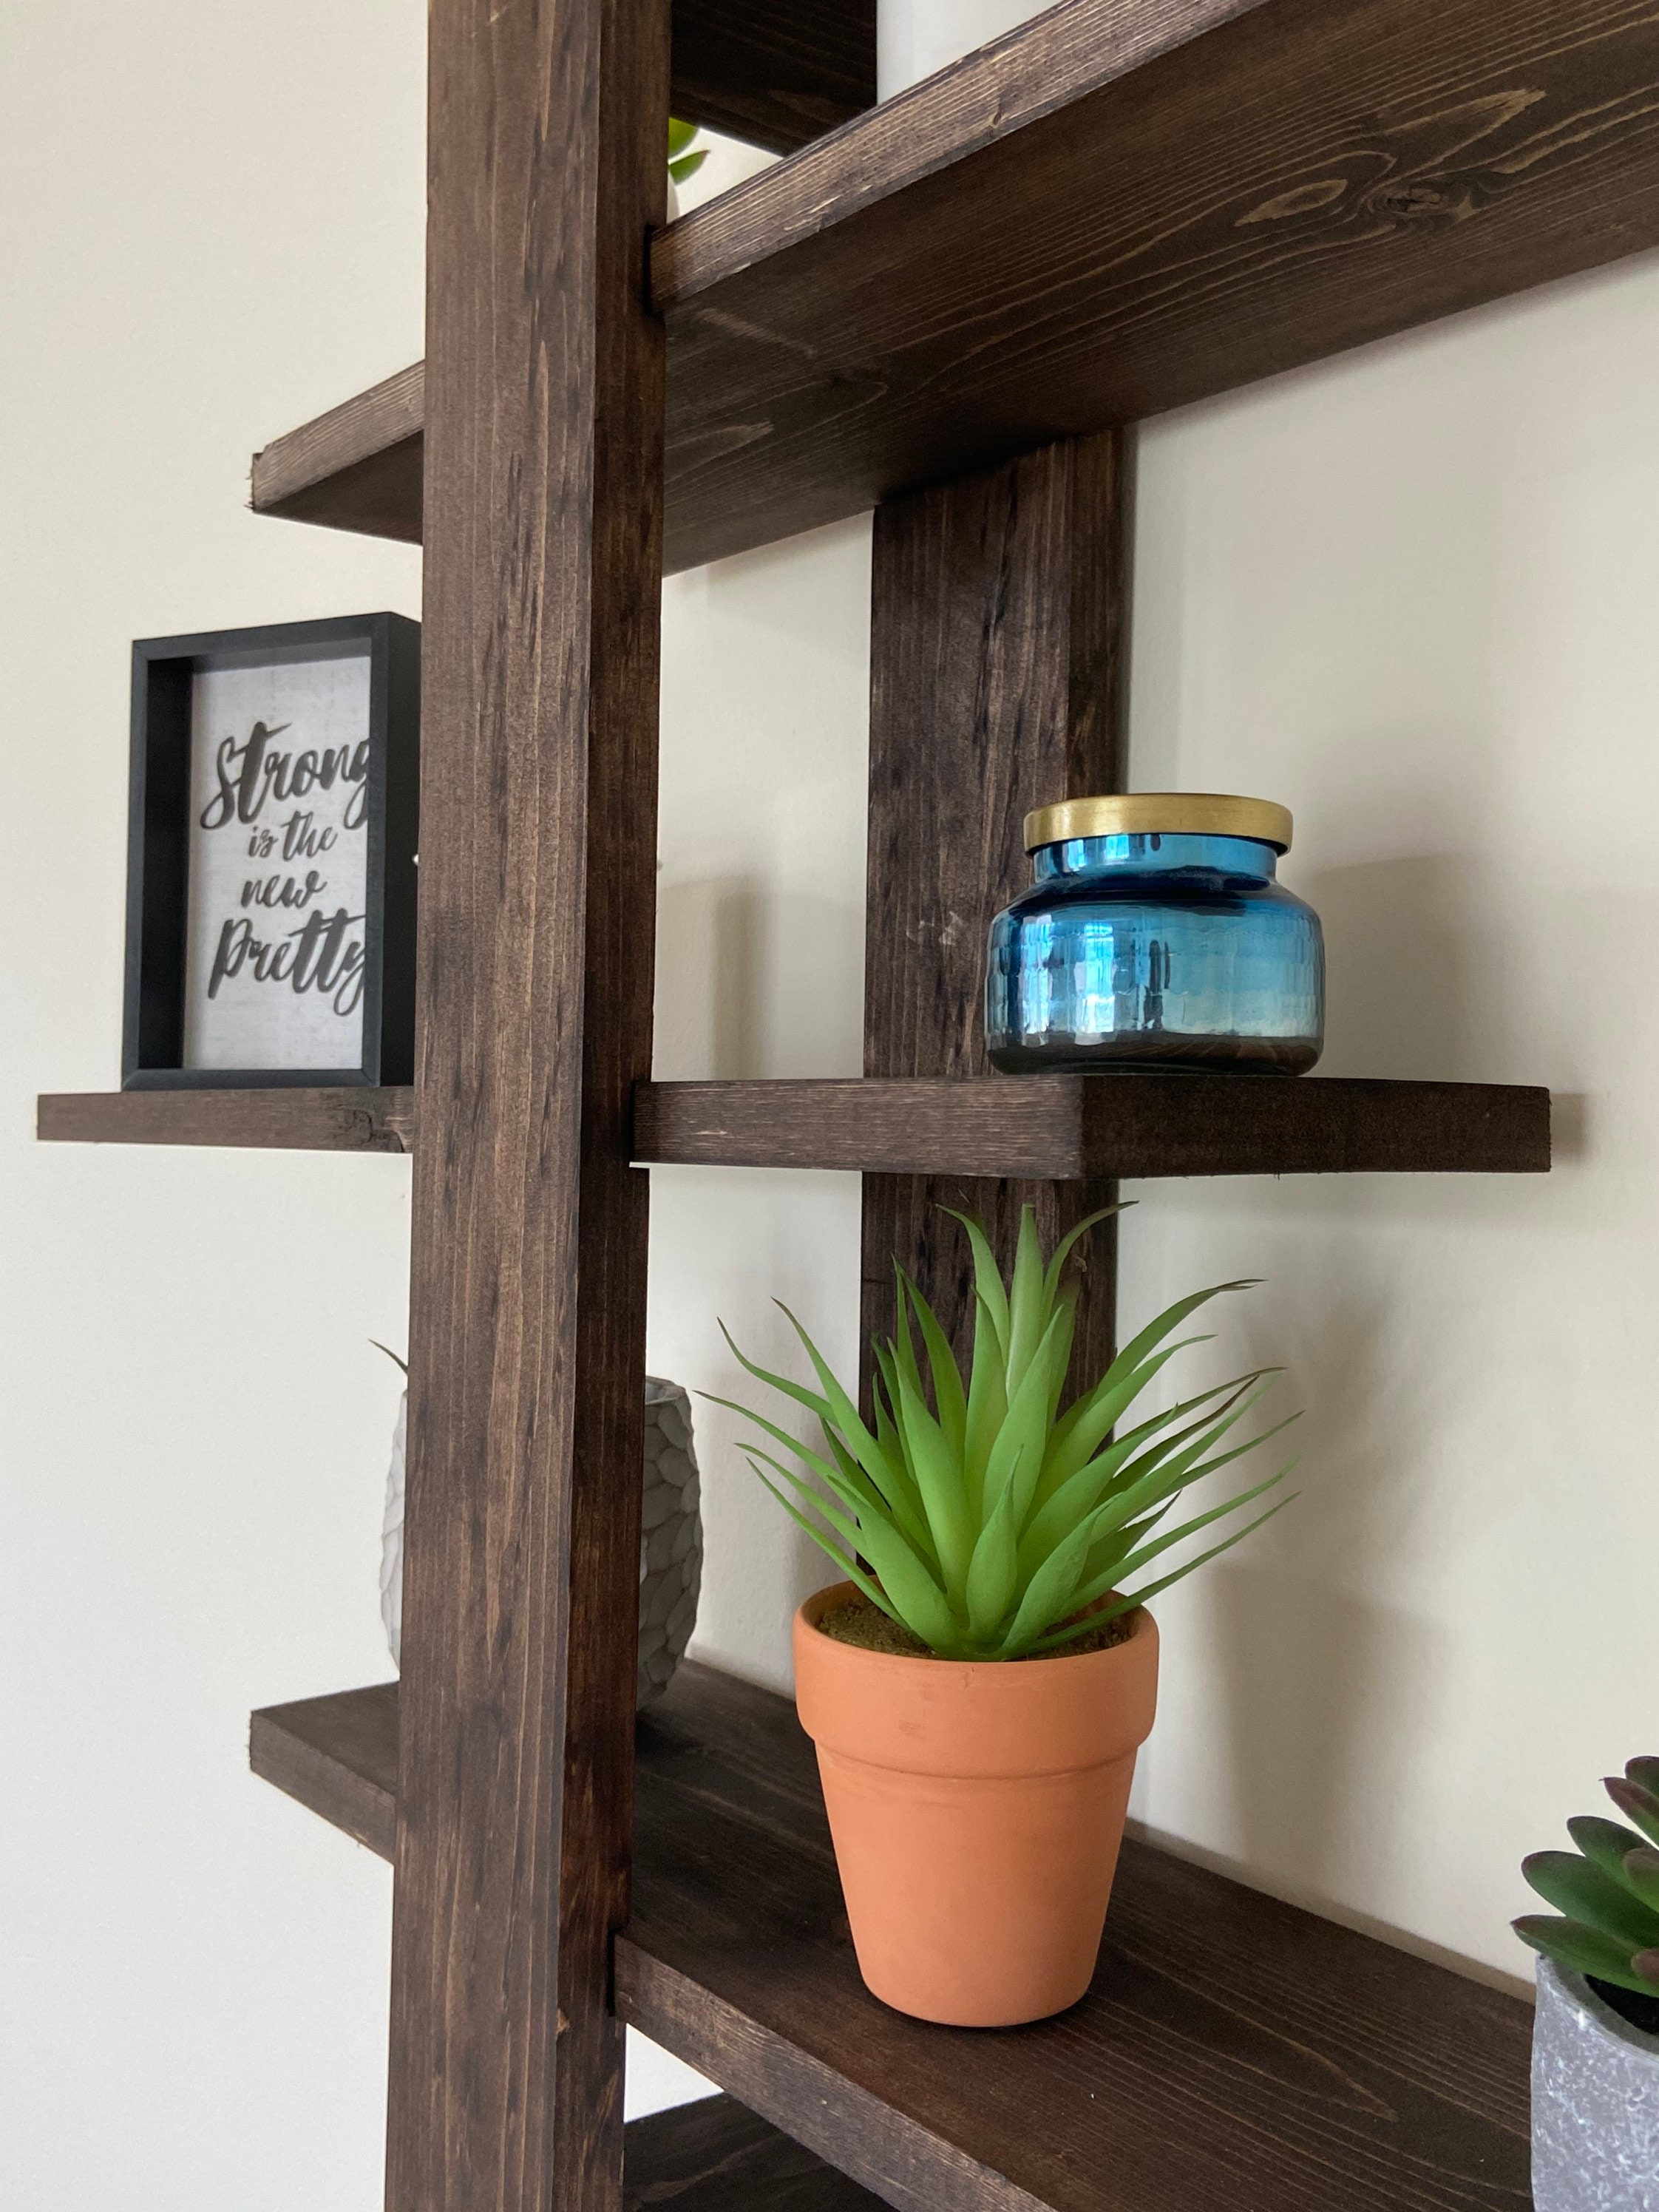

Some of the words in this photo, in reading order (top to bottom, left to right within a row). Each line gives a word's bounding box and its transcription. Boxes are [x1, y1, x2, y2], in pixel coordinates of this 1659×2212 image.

[200, 722, 370, 830] Strong
[248, 826, 277, 858] is
[281, 810, 337, 861] the
[241, 870, 328, 908] new
